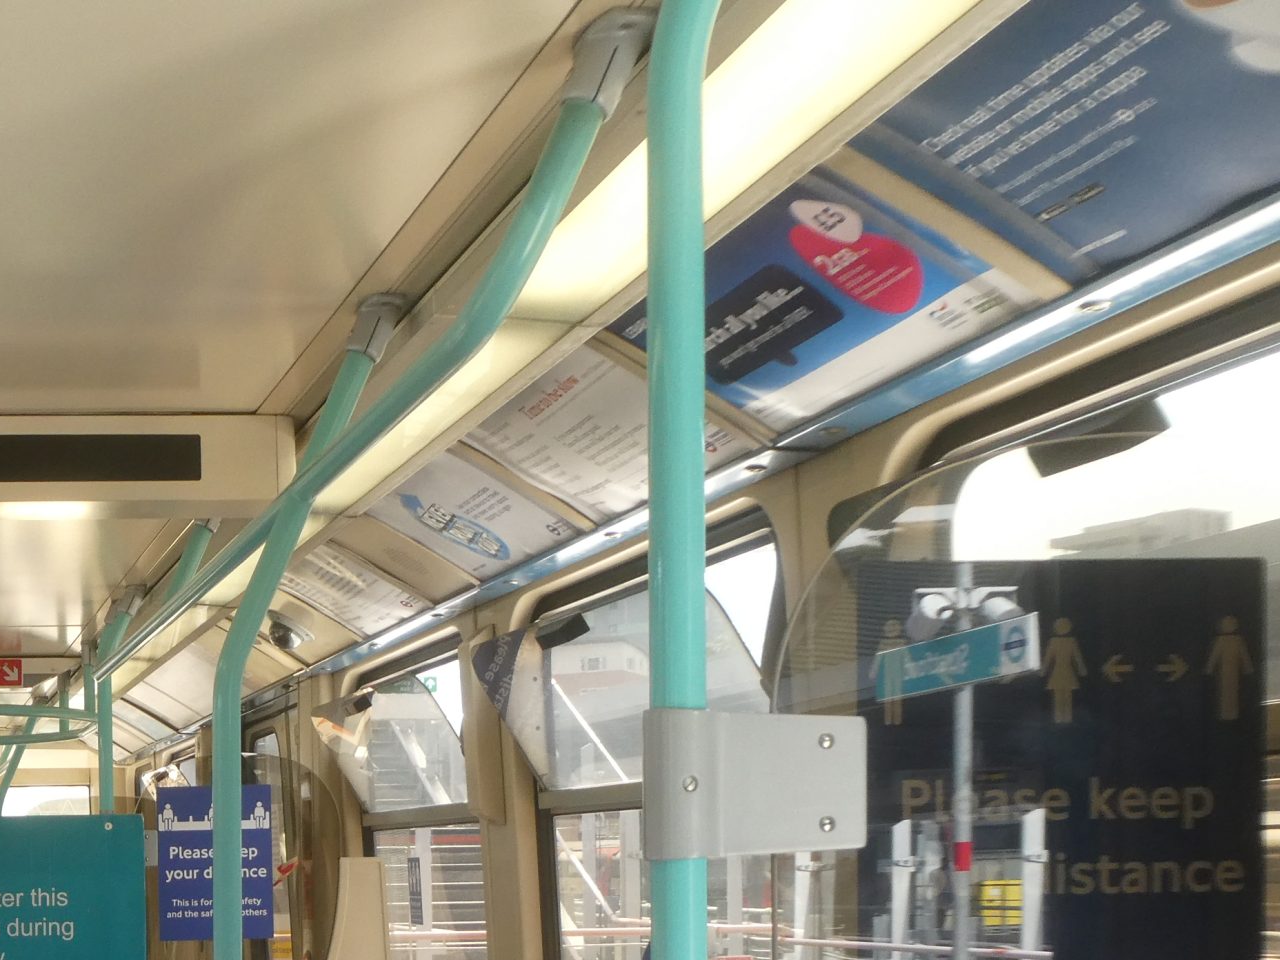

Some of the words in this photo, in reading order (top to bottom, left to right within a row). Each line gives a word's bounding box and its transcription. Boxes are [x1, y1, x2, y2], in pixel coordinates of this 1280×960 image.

[1021, 40, 1091, 91] updates
[1083, 21, 1115, 47] via
[1061, 58, 1106, 95] apps
[1100, 36, 1138, 68] and
[1133, 15, 1171, 47] see
[1093, 58, 1148, 106] cuppa
[900, 778, 1071, 822] Plase
[1089, 778, 1216, 829] keep
[169, 847, 213, 859] Please
[241, 848, 257, 860] ep
[166, 868, 199, 883] your
[203, 867, 267, 879] dnce
[1048, 852, 1246, 896] istance
[31, 888, 68, 906] this
[200, 898, 212, 906] for
[242, 897, 262, 905] afety
[7, 918, 73, 940] during
